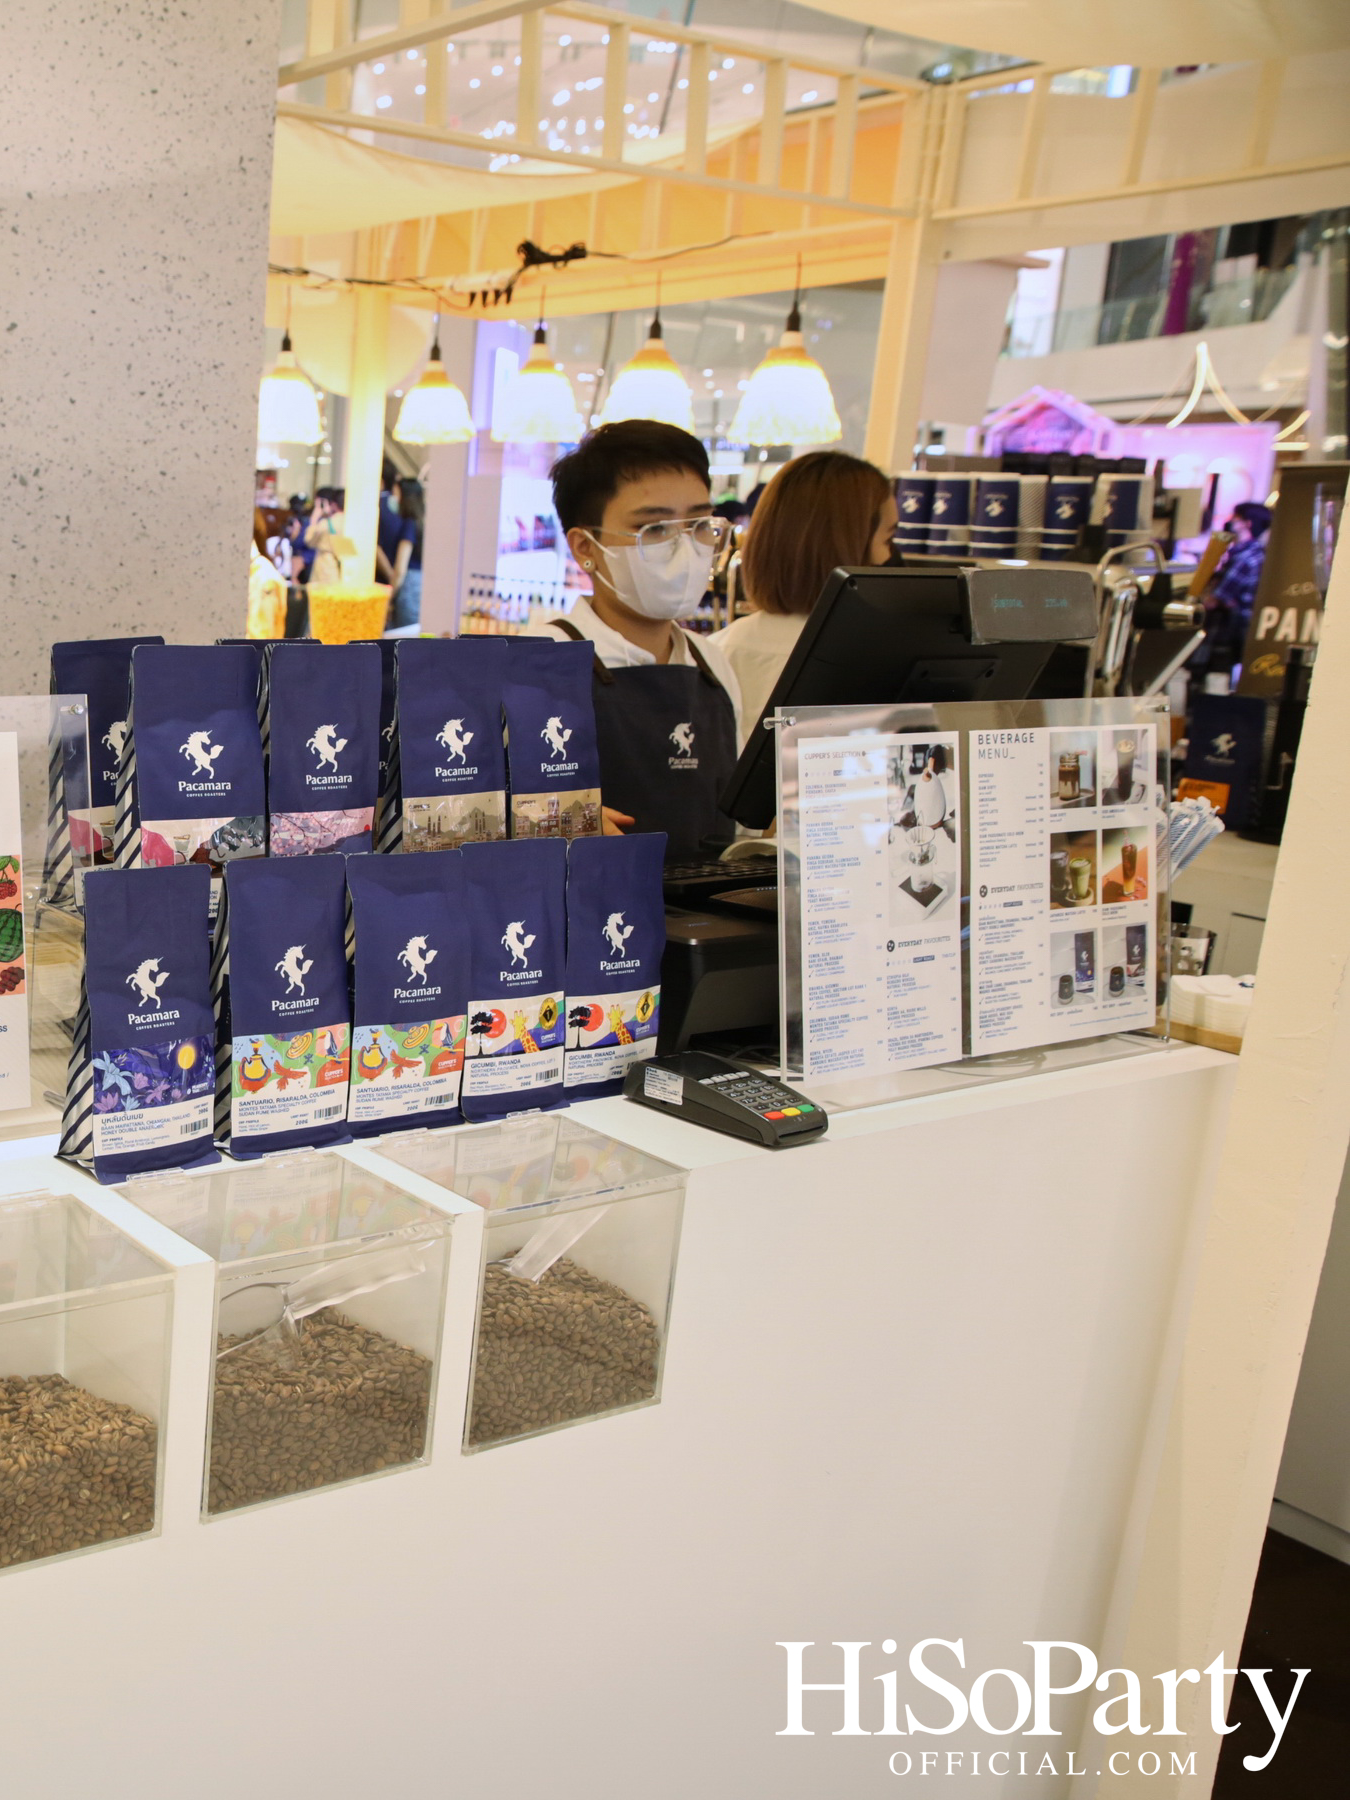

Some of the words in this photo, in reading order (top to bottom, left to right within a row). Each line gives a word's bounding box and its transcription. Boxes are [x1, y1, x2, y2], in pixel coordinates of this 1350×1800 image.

[978, 732, 1034, 744] BEVERAGE
[435, 766, 478, 777] Pacamara
[540, 762, 578, 772] Pacamara
[305, 774, 352, 785] Pacamara
[178, 781, 231, 791] Pacamara
[600, 959, 640, 971] Pacamara
[500, 969, 542, 982] Pacamara
[393, 986, 441, 998] Pacamara
[271, 997, 319, 1011] Pacamara
[128, 1009, 179, 1025] Pacamara
[309, 1089, 335, 1098] COLOMBIA
